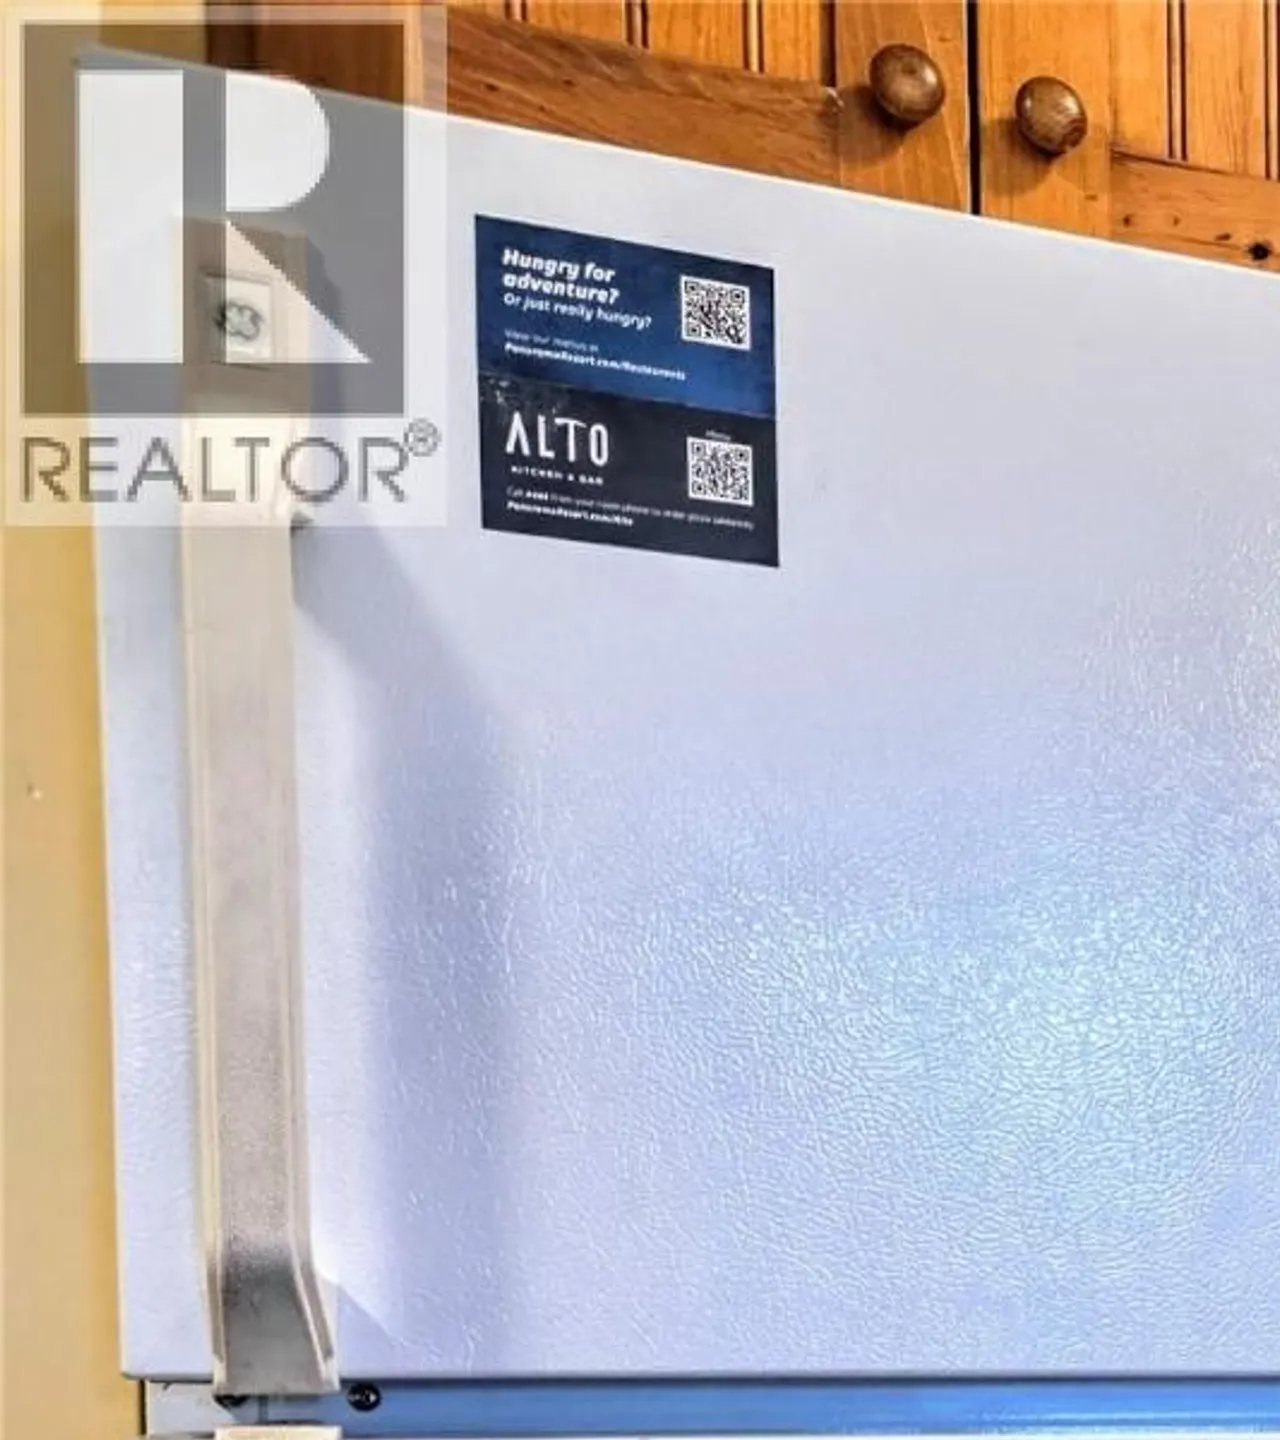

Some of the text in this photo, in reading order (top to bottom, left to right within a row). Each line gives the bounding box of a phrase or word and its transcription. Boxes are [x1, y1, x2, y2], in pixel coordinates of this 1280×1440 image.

[502, 247, 616, 283] Hungry for
[502, 272, 621, 305] adventure?
[503, 292, 653, 331] Or just really hungry?
[504, 410, 609, 468] ALTO
